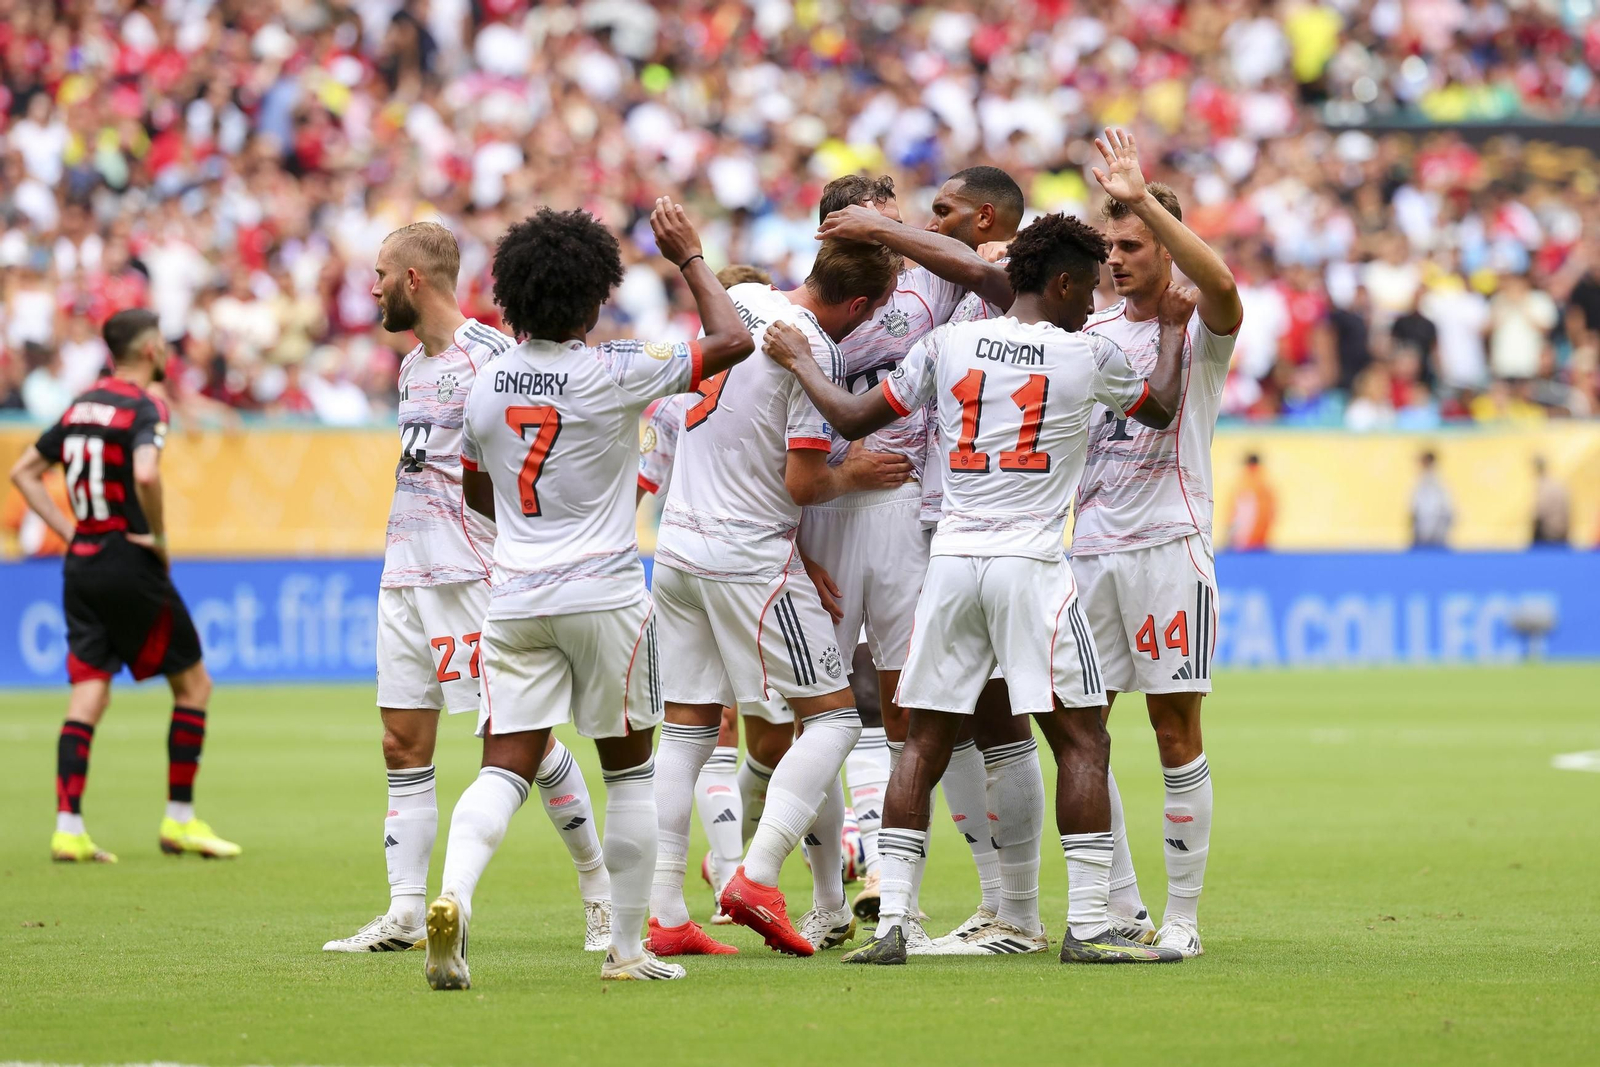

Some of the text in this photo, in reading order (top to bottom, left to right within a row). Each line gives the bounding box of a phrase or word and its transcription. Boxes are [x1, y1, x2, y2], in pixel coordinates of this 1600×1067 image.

[975, 337, 1045, 366] COMAN
[494, 369, 569, 396] GNABRY
[949, 368, 1050, 473] 11
[62, 434, 110, 521] 21
[504, 405, 561, 517] 7
[431, 631, 482, 683] 27
[1135, 610, 1189, 660] 44
